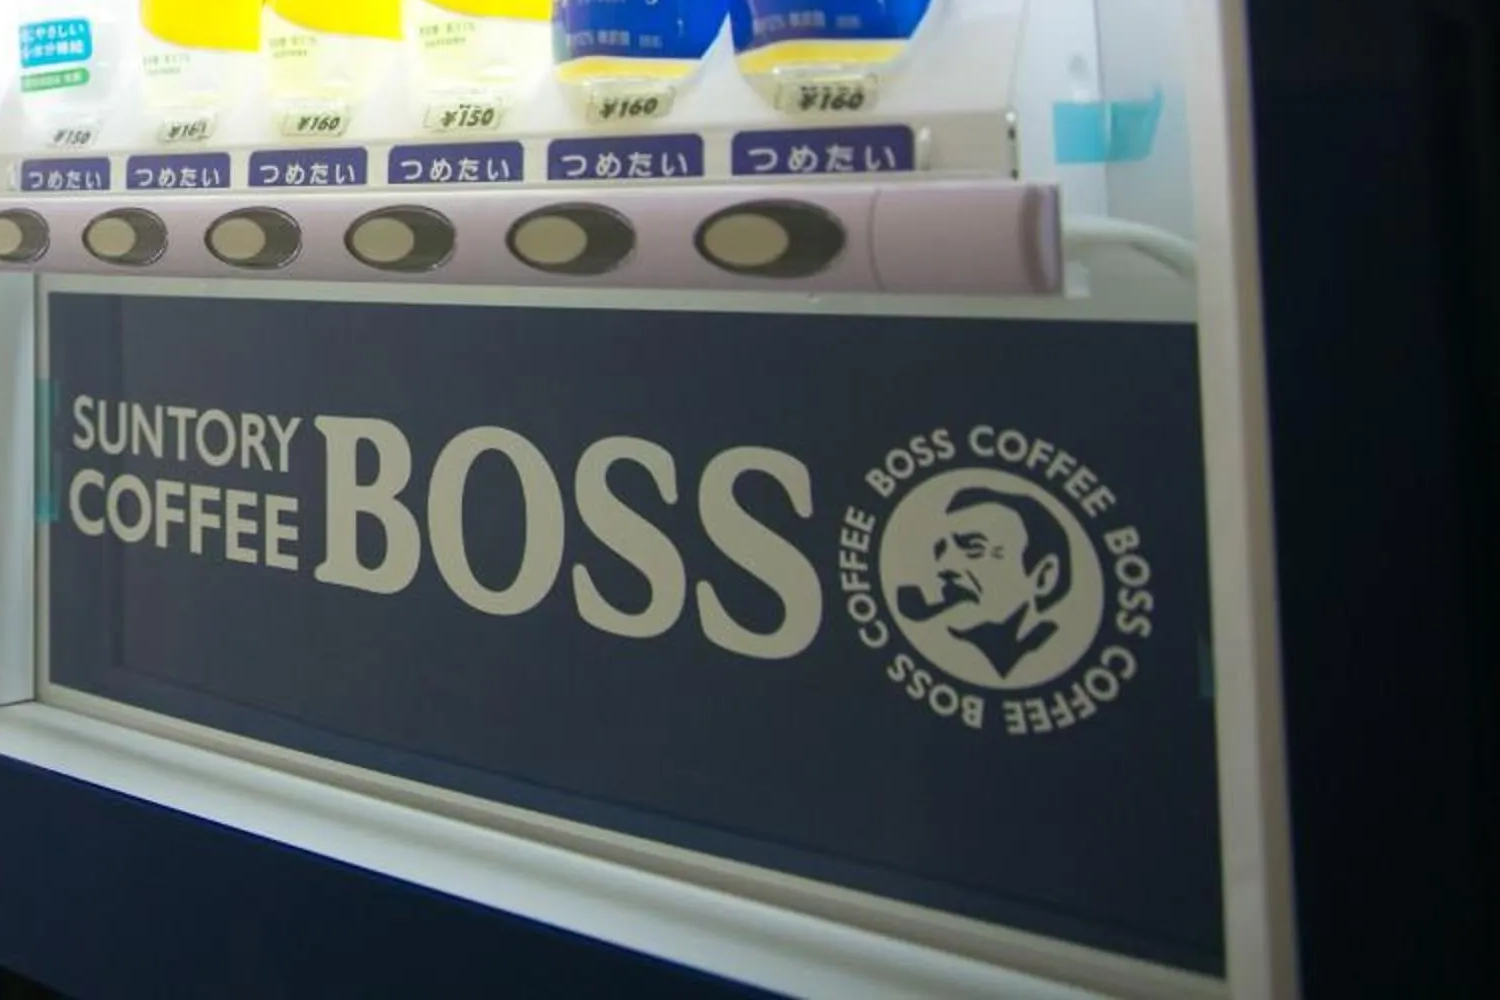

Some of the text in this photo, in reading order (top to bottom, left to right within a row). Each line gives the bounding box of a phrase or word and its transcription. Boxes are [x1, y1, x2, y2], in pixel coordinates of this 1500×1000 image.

[439, 105, 496, 129] ¥150
[599, 96, 659, 120] ¥160
[297, 115, 341, 132] ¥160
[400, 157, 511, 182] つめたい
[560, 151, 689, 179] つめたい
[747, 144, 897, 172] つめたい
[27, 170, 101, 190] つめたい
[134, 167, 221, 188] つめたい
[259, 163, 356, 185] つめたい
[72, 394, 303, 474] SUNTORY
[864, 424, 1117, 518] BOSS COFFEE
[68, 467, 300, 572] COFFEE
[313, 414, 823, 660] BOSS
[839, 505, 985, 729] BOSS COFFEE
[1002, 525, 1154, 735] BOSS COFFEE
